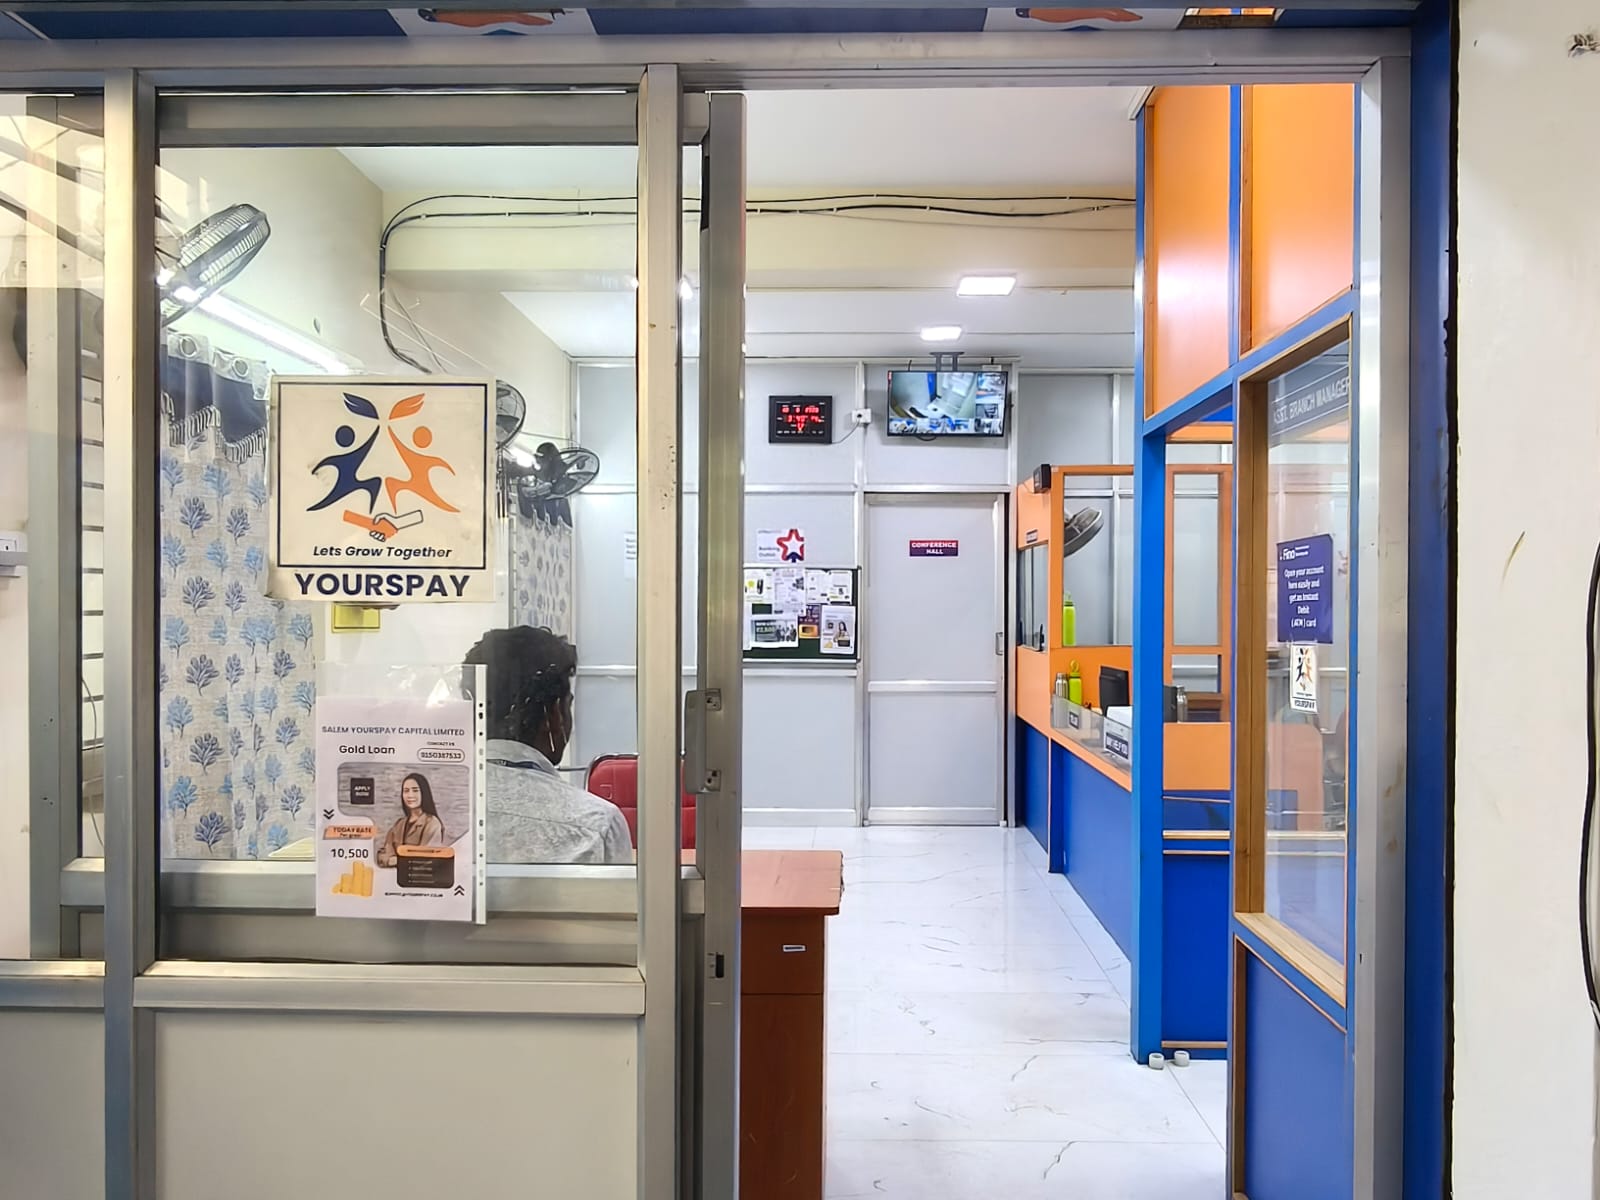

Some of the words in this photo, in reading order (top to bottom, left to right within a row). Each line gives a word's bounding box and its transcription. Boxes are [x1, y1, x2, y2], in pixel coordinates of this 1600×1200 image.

[1289, 393, 1315, 419] BRANCH
[313, 546, 342, 557] Lets
[345, 546, 382, 557] Grow
[387, 546, 453, 560] Together
[294, 573, 470, 597] YOURSPAY
[350, 726, 396, 735] YOURSPAY
[398, 727, 432, 736] CAPITAL
[433, 728, 465, 736] LIMITED
[338, 745, 365, 754] Gold
[368, 745, 396, 755] Loan
[330, 848, 369, 859] 10,500
